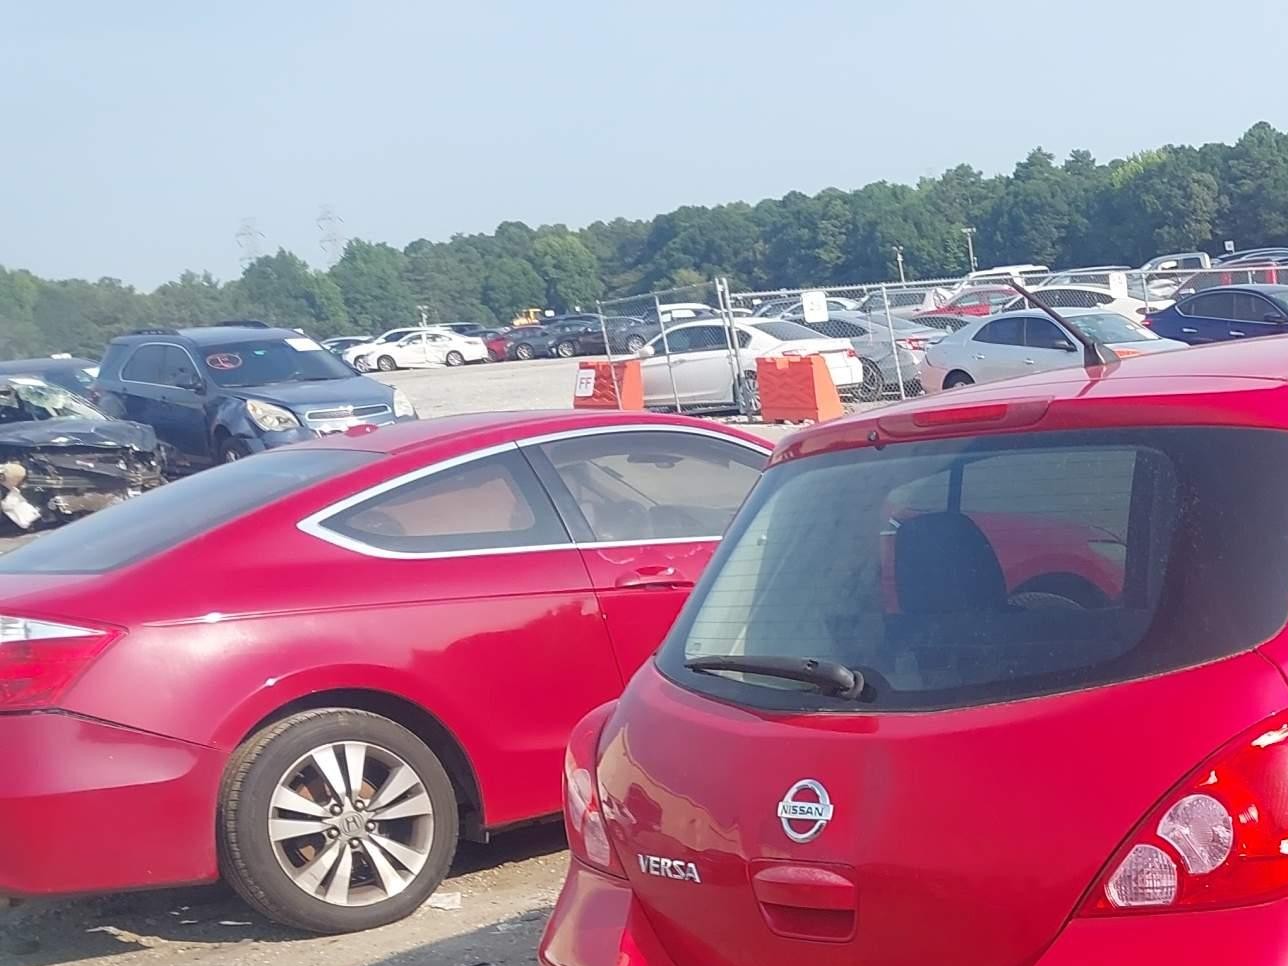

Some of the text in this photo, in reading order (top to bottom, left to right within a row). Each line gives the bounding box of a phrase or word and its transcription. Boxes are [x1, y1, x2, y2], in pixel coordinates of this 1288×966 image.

[578, 376, 593, 390] FF
[780, 804, 825, 817] NISSAN
[637, 853, 701, 883] VERSA
